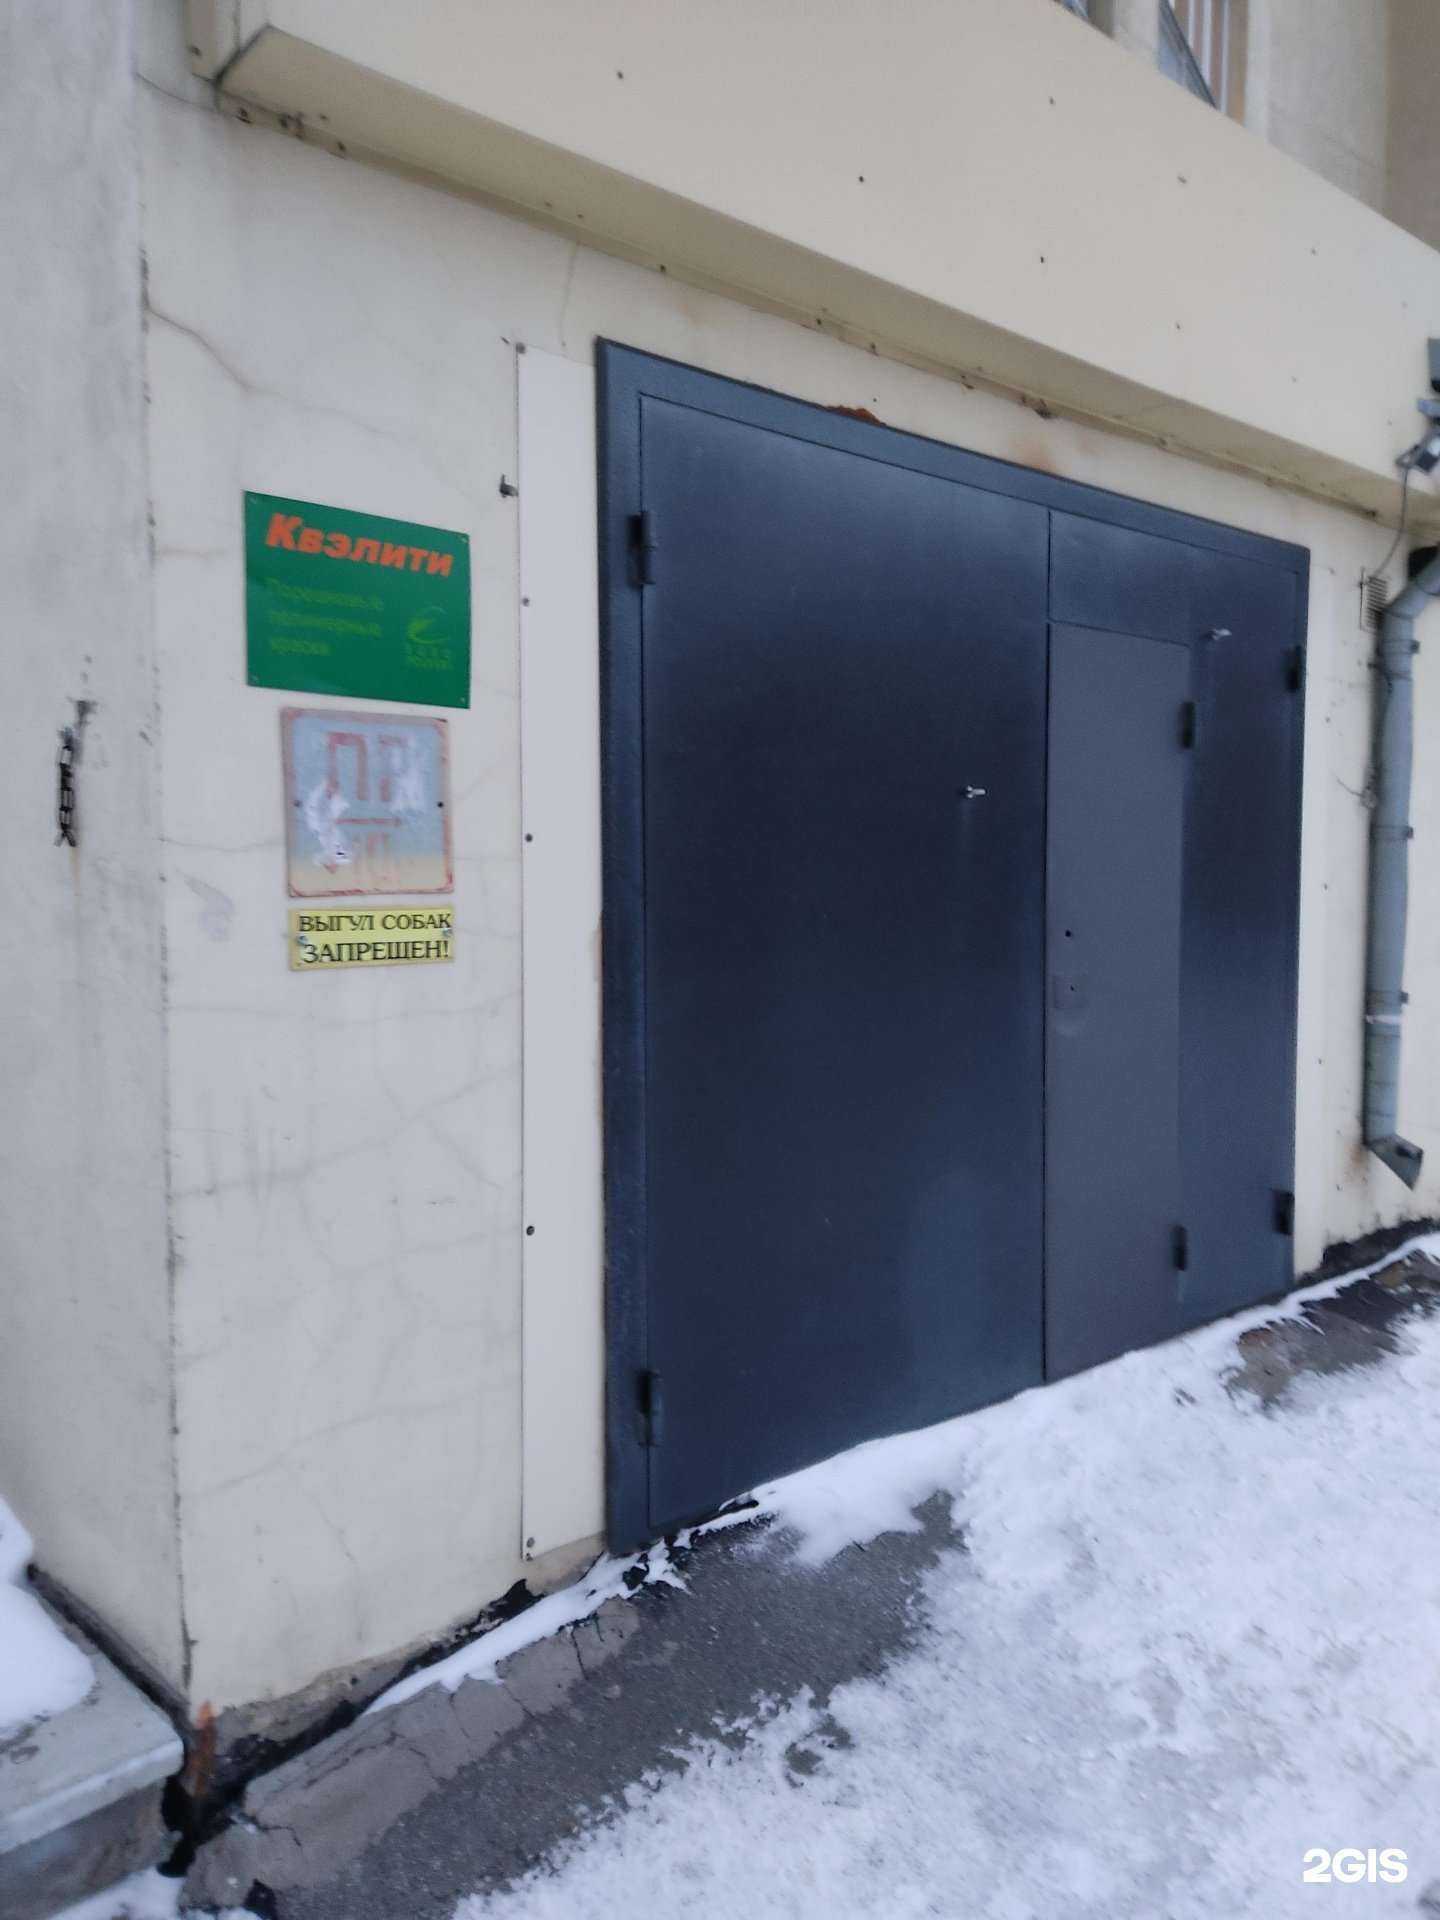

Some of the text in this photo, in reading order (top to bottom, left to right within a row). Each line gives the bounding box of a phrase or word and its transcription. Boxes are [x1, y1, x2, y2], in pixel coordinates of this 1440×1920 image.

[266, 513, 454, 576] Квэлити
[299, 912, 452, 932] ВЫГУЛ СОБАК
